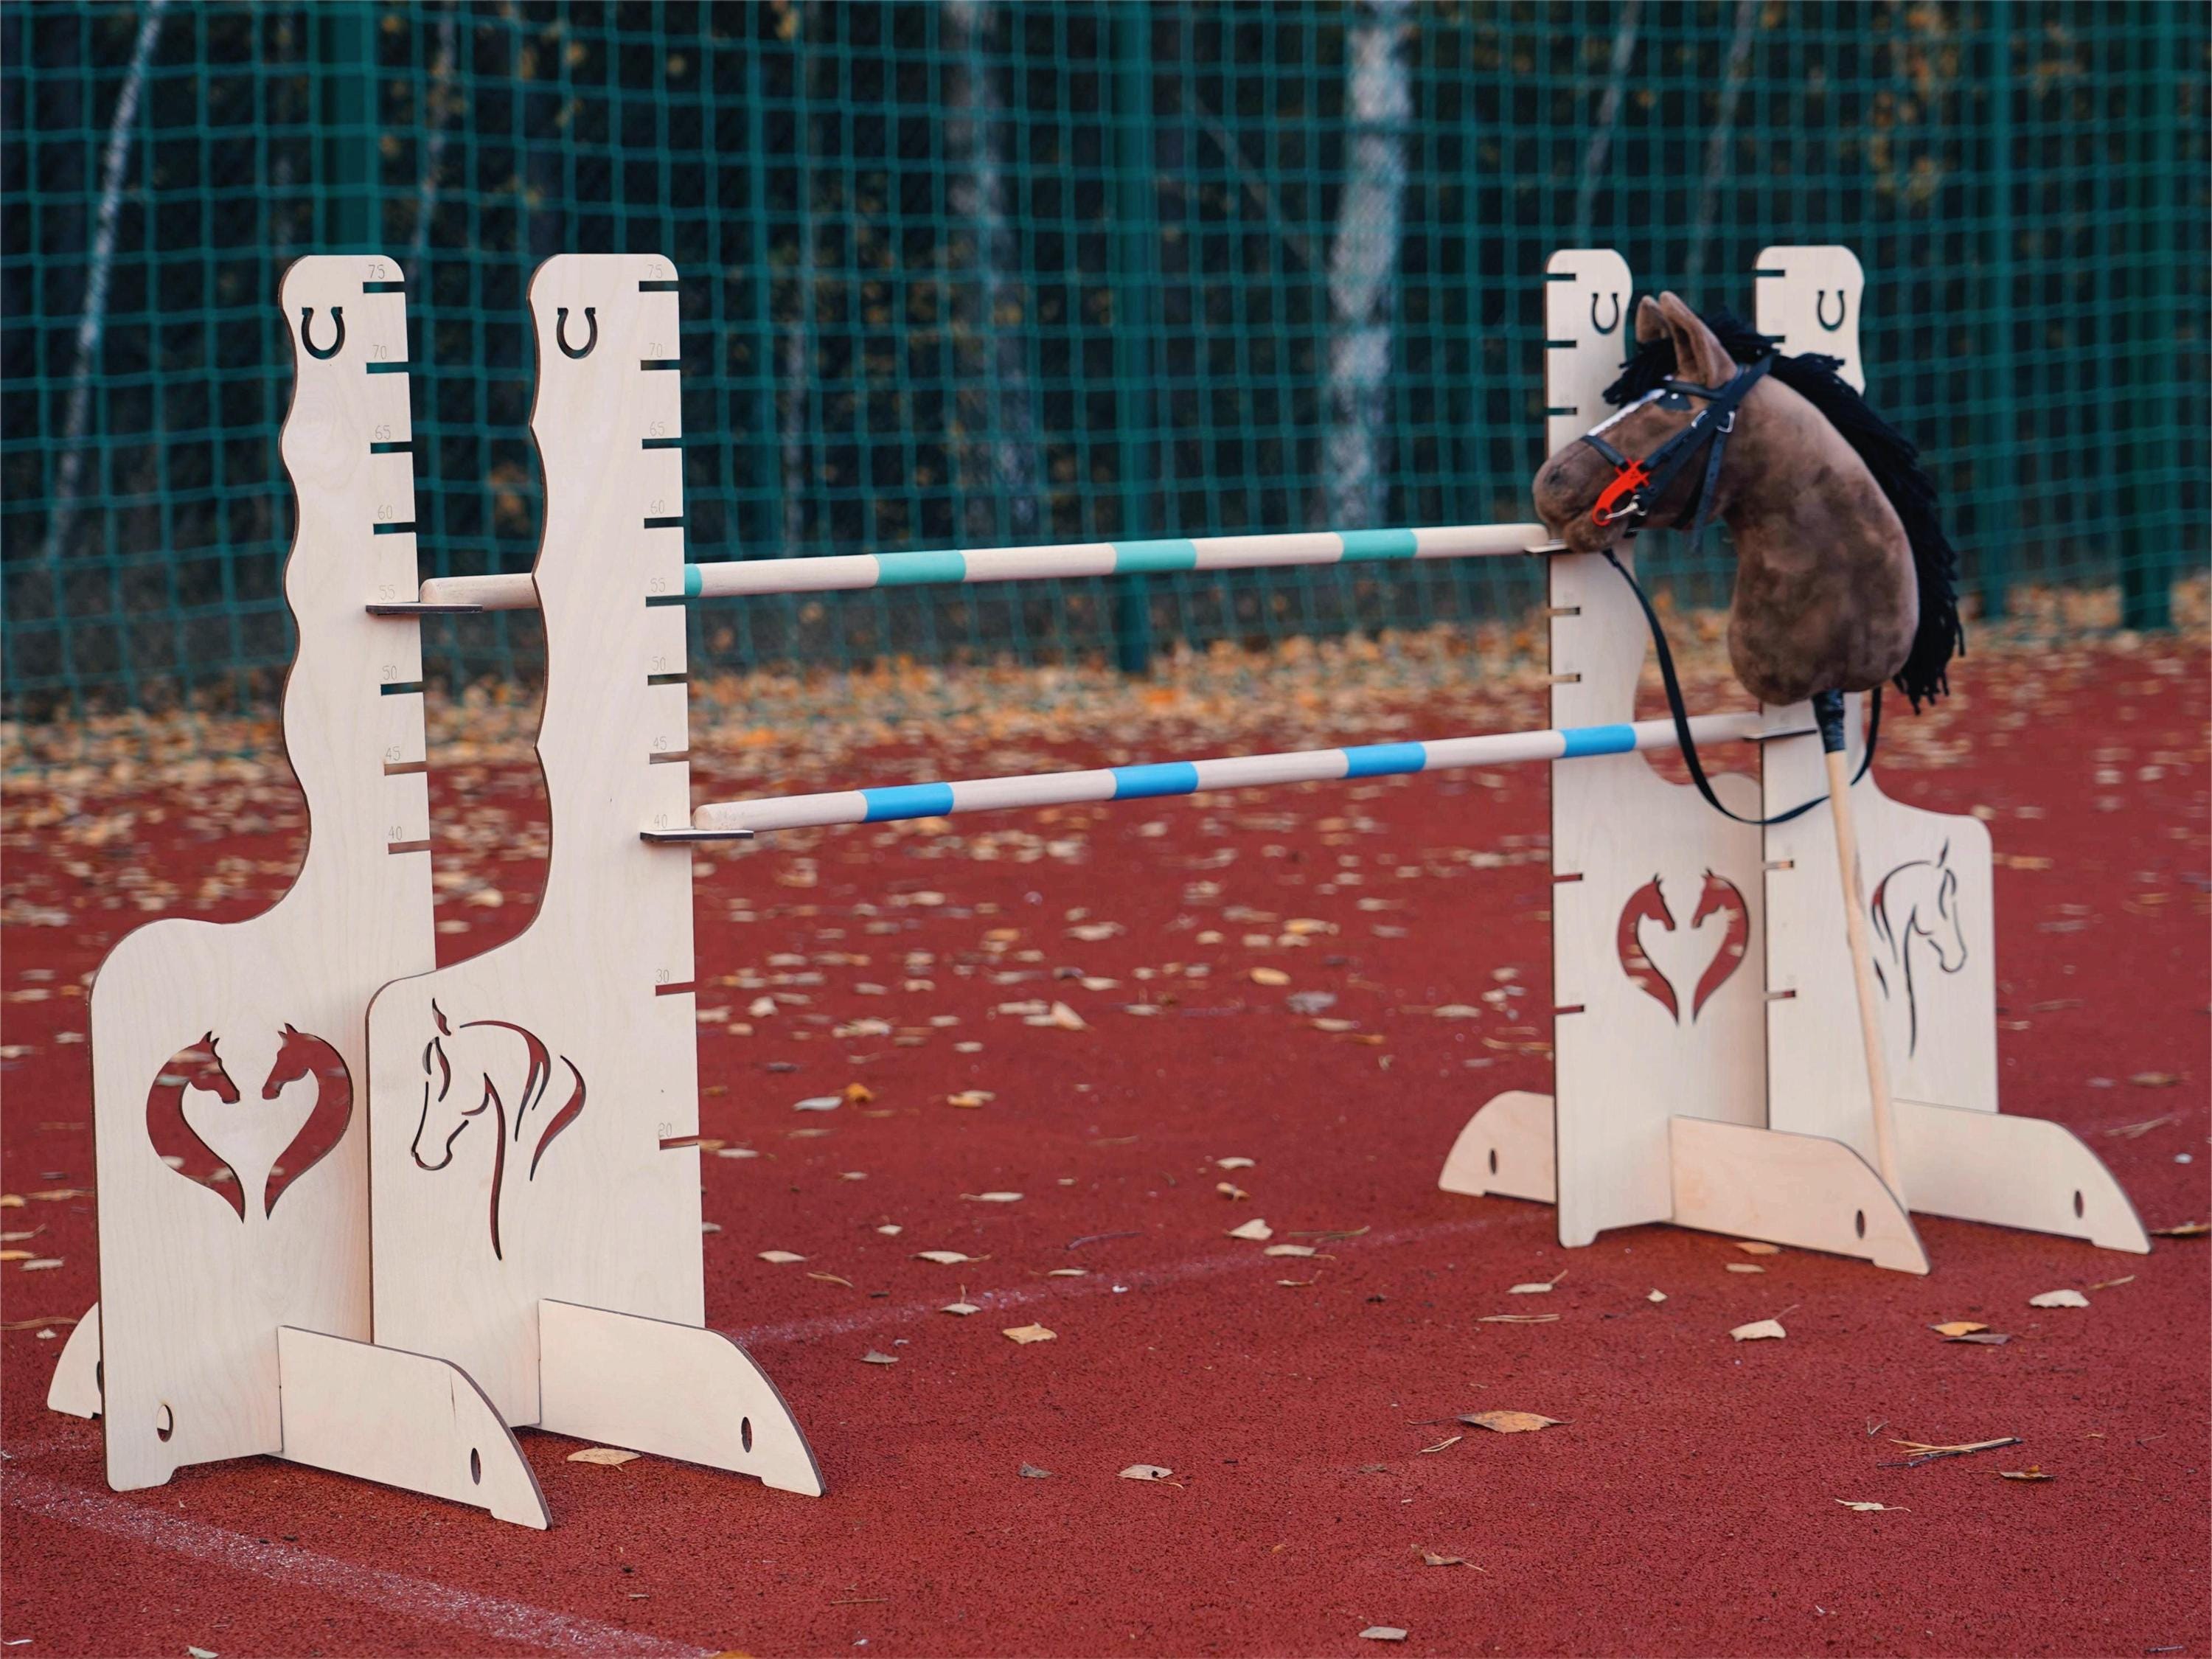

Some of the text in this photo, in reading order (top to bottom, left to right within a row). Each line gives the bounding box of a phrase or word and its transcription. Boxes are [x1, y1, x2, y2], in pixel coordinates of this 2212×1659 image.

[368, 265, 386, 279] 75
[647, 265, 662, 278] 75
[372, 345, 387, 360] 70
[650, 343, 662, 357] 70
[375, 425, 391, 439] 65
[650, 422, 664, 437] 65
[378, 505, 393, 520] 60
[650, 500, 664, 514] 60
[650, 578, 666, 592] 55
[380, 585, 396, 600] 55
[652, 657, 666, 671] 50
[383, 666, 397, 681] 50
[653, 737, 667, 751] 45
[386, 746, 401, 761] 45
[654, 814, 667, 828] 40
[389, 825, 403, 840] 40
[655, 970, 669, 984] 30
[658, 1123, 672, 1138] 20
